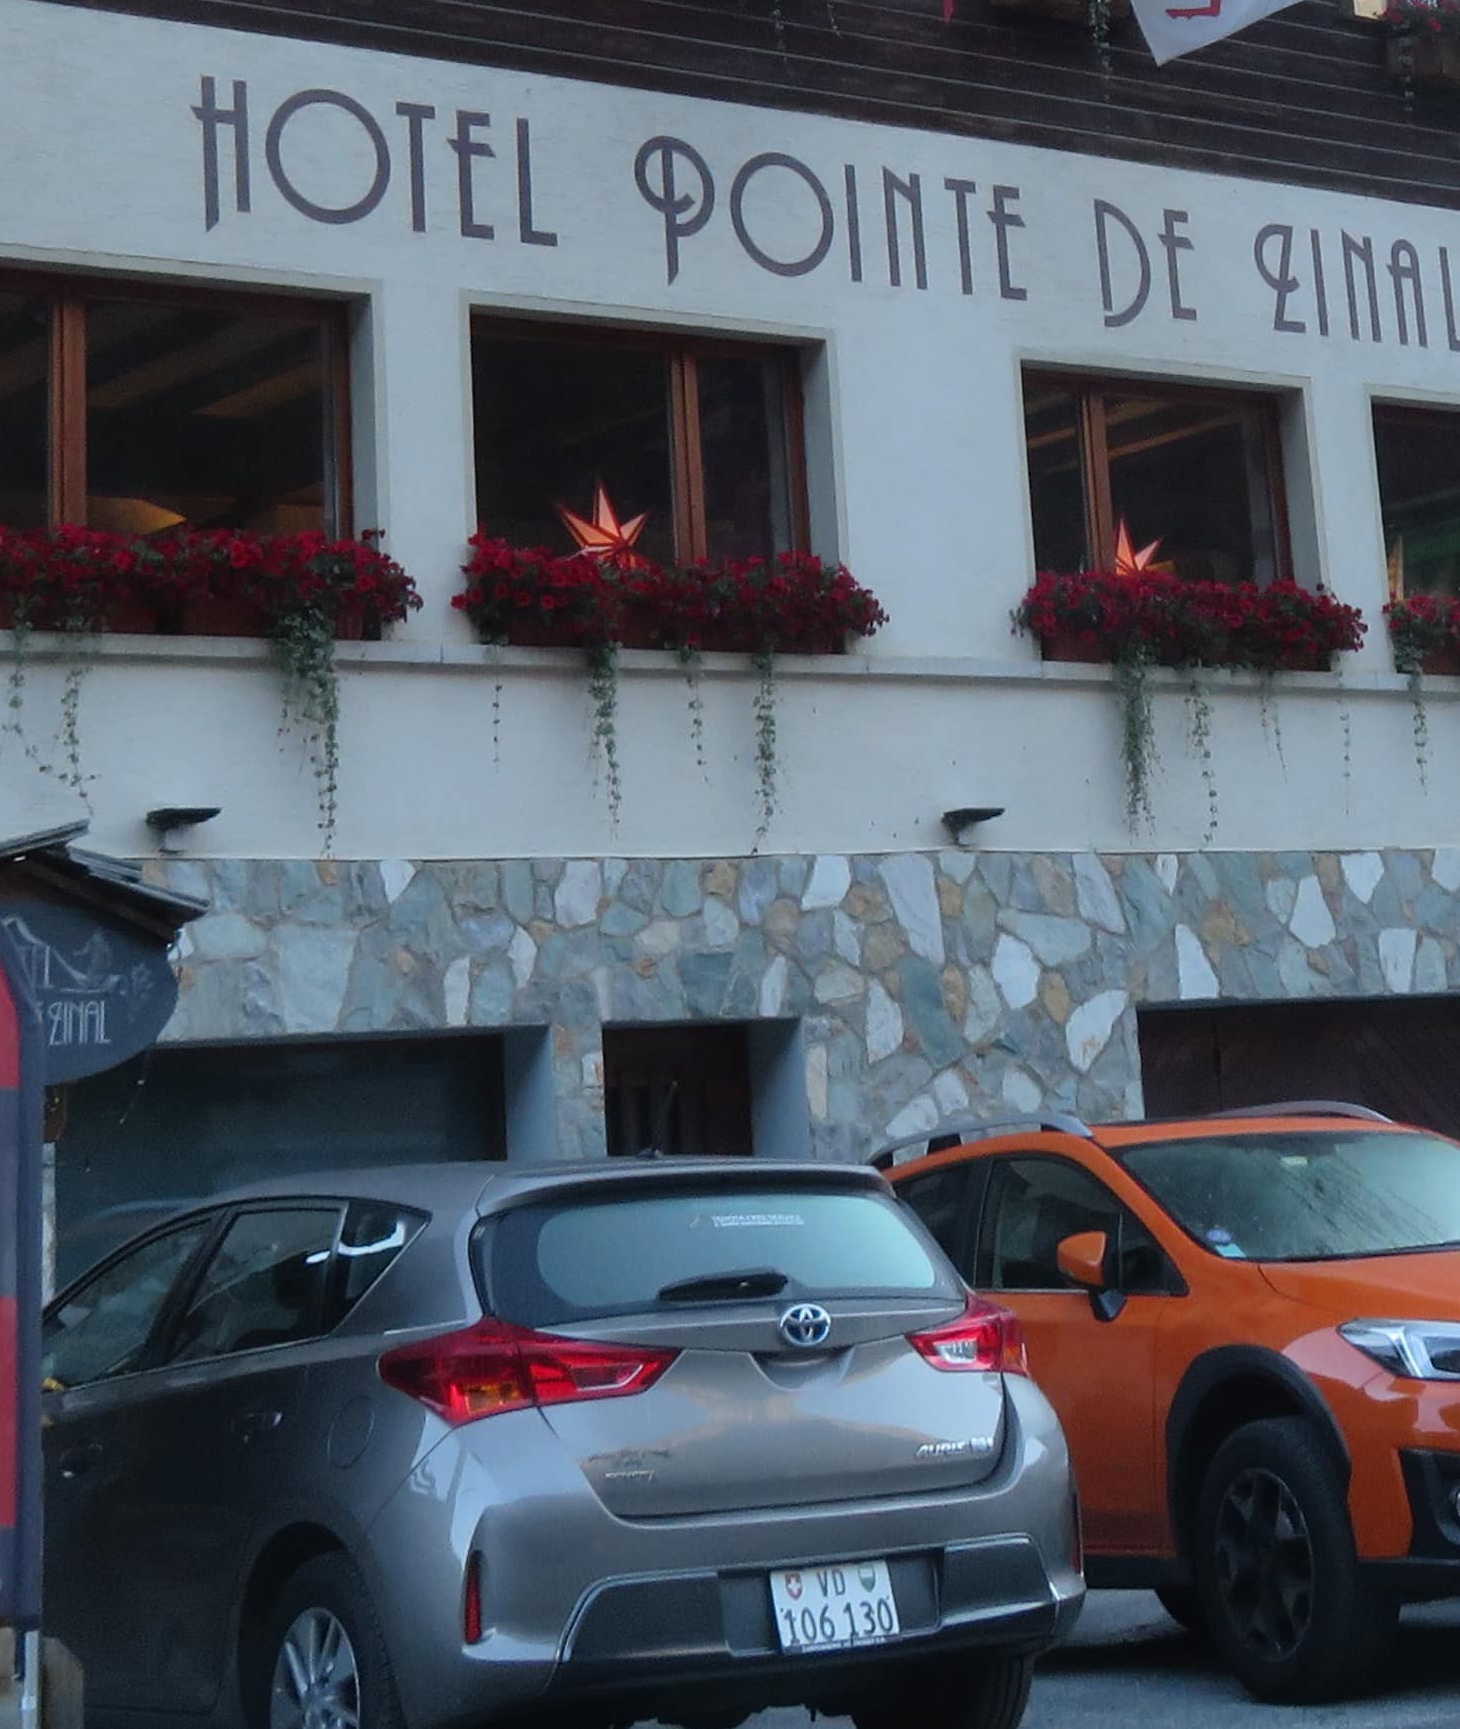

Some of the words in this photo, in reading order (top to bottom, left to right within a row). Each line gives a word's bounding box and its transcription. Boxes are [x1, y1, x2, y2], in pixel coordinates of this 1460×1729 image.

[192, 75, 558, 247] HOTEL
[634, 135, 1027, 302] POINTE
[1095, 198, 1198, 328] DE
[48, 1000, 111, 1046] ZINAL
[816, 1569, 846, 1598] VD
[784, 1604, 835, 1642] 106
[844, 1598, 894, 1636] 130
